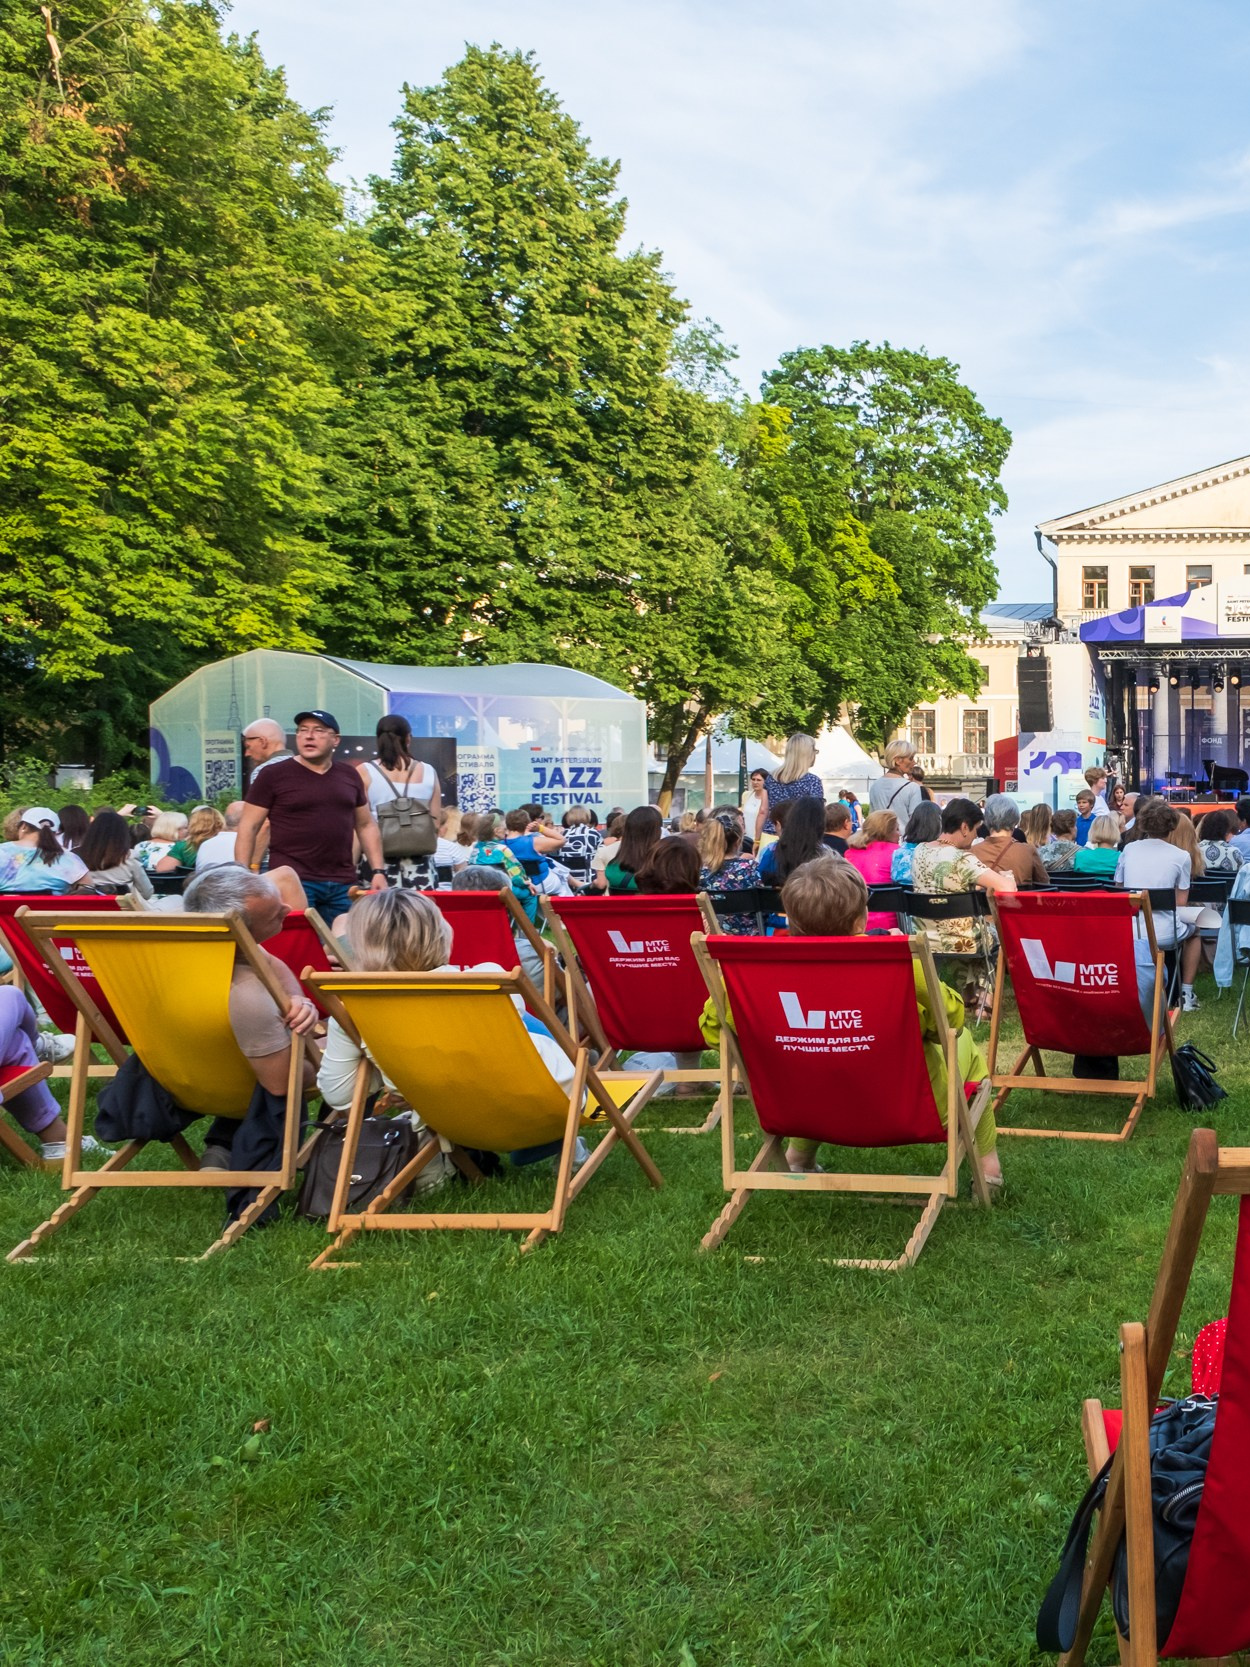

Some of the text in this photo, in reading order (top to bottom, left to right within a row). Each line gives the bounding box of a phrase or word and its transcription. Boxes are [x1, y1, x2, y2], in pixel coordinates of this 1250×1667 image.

[532, 767, 602, 789] JAZZ
[532, 793, 603, 805] FESTIVAL
[1080, 963, 1118, 975] МТС
[1081, 975, 1119, 986] LIVE
[829, 1010, 862, 1020] МТС
[830, 1019, 863, 1029] LIVE
[775, 1035, 825, 1044] ДЕРЖИМ
